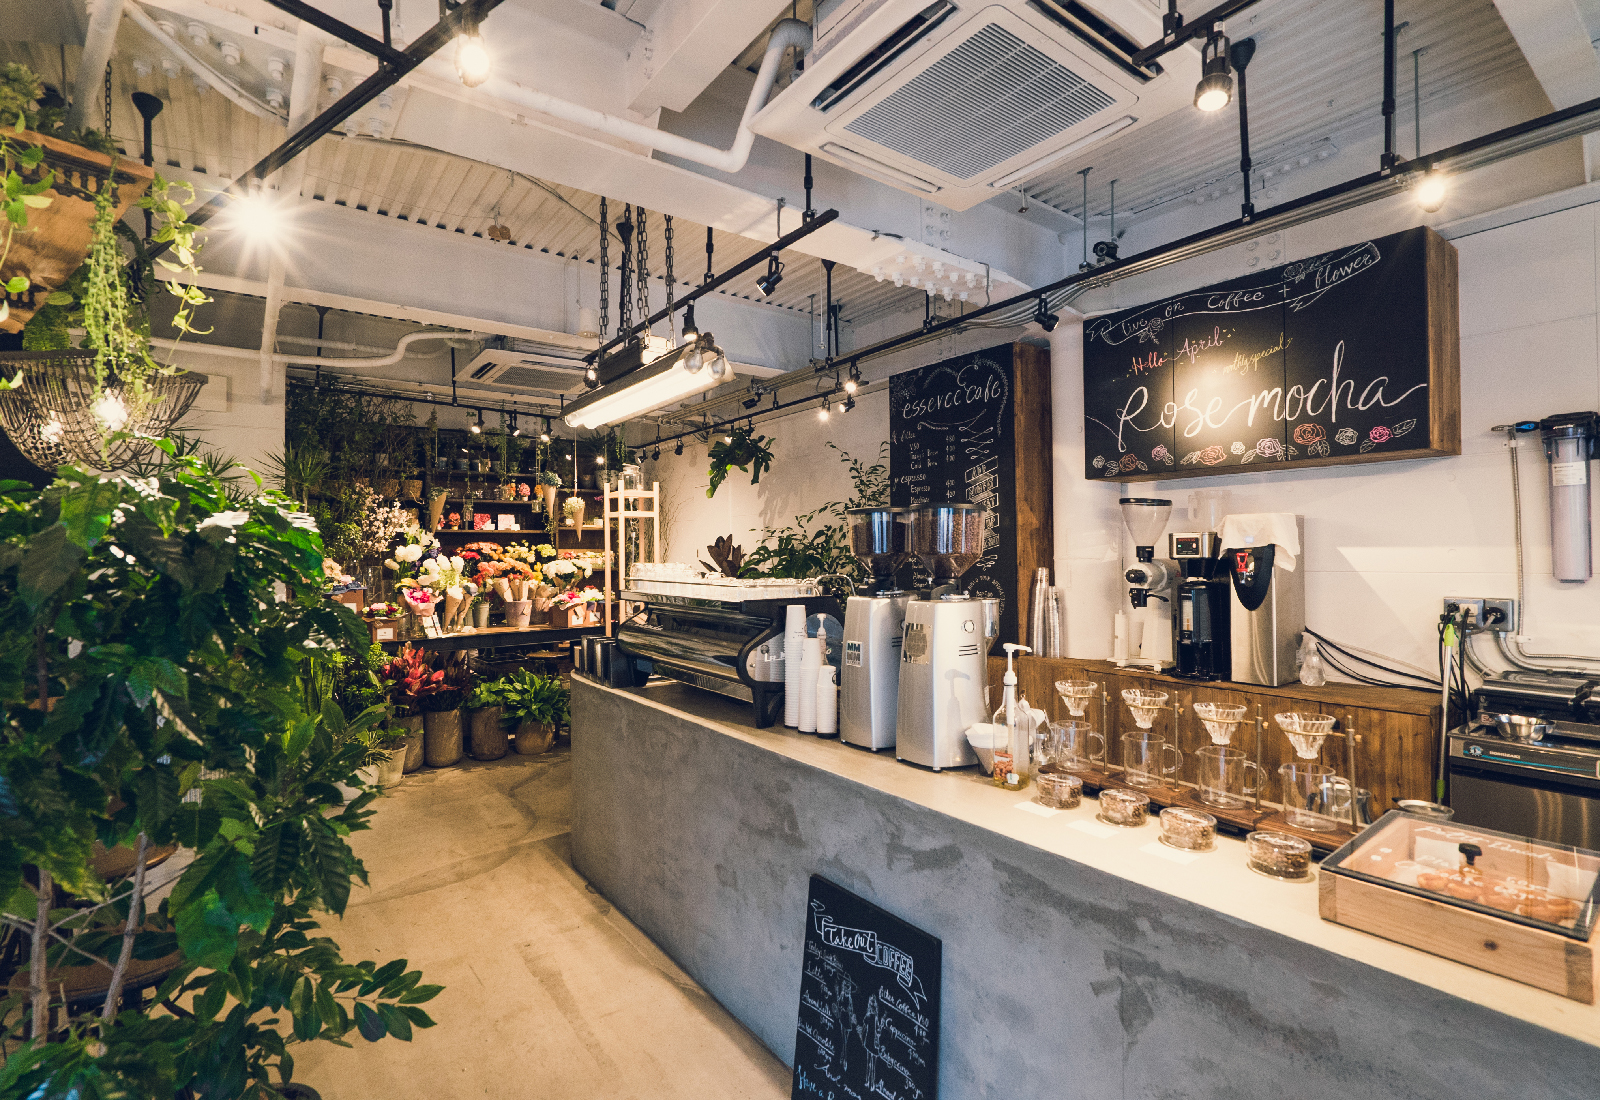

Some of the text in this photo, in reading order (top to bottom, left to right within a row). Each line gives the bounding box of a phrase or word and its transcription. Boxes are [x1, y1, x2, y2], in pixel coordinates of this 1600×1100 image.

[1165, 302, 1185, 318] on
[1207, 291, 1265, 310] Coffee
[1315, 252, 1373, 289] flower
[1132, 326, 1226, 376] Hello April
[1249, 331, 1288, 372] special
[1112, 339, 1426, 453] Rose mocha
[876, 943, 913, 981] COFFEE
